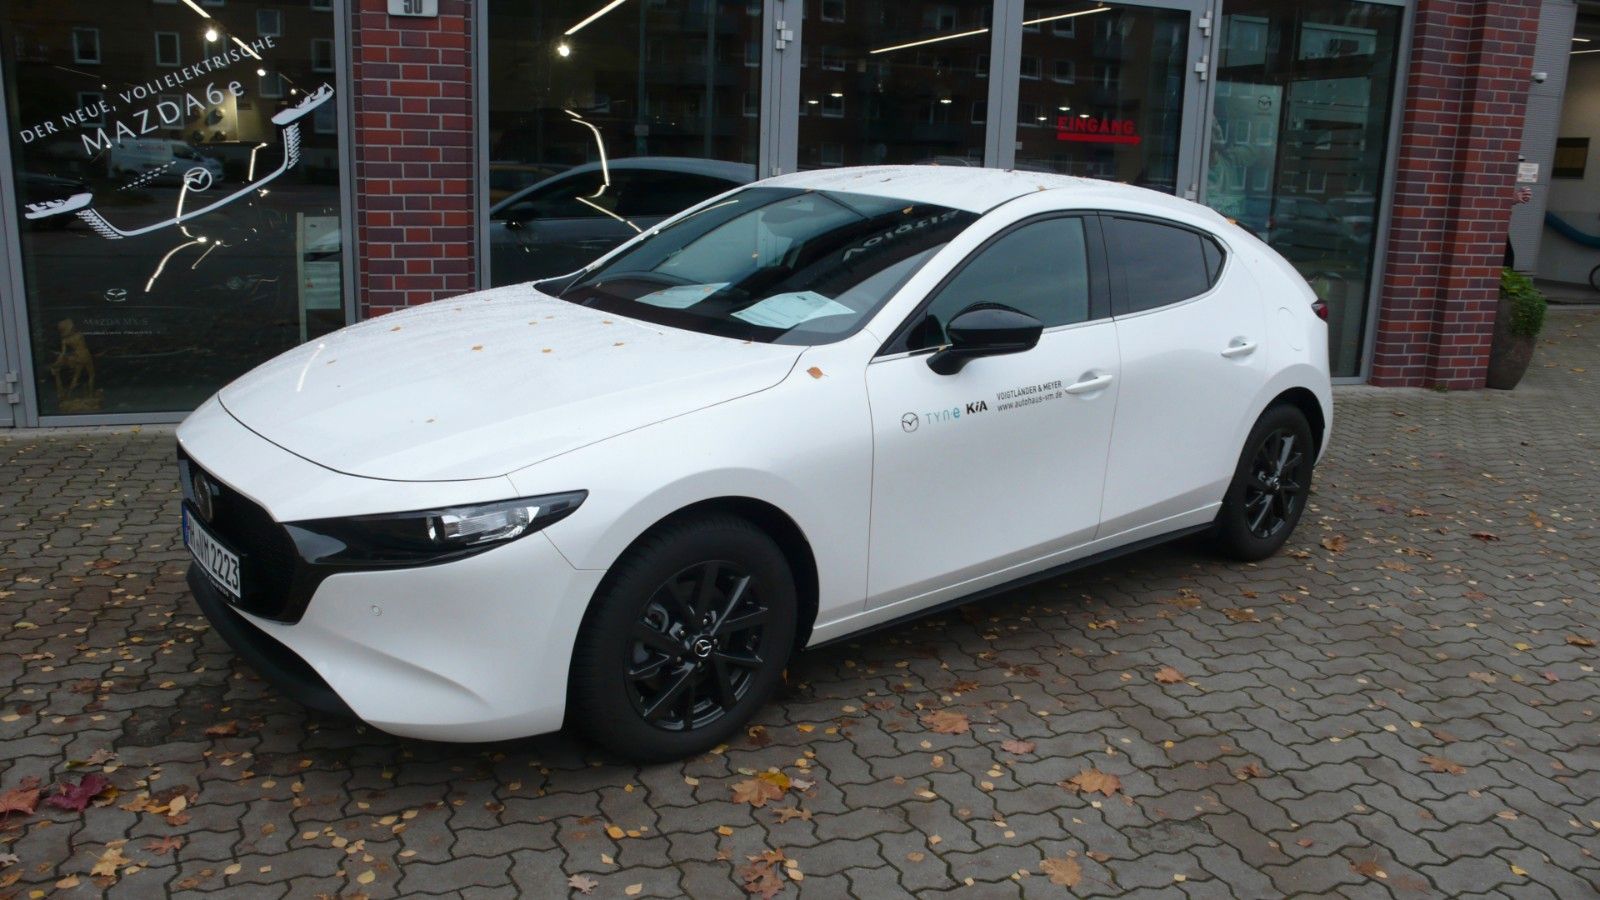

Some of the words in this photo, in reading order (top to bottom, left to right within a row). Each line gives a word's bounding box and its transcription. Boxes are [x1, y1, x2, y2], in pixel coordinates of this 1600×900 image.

[19, 121, 59, 145] DER
[62, 99, 117, 129] NEUE,
[1057, 115, 1136, 134] EINGANG
[1043, 380, 1062, 391] MEYER
[211, 543, 239, 591] 2223
